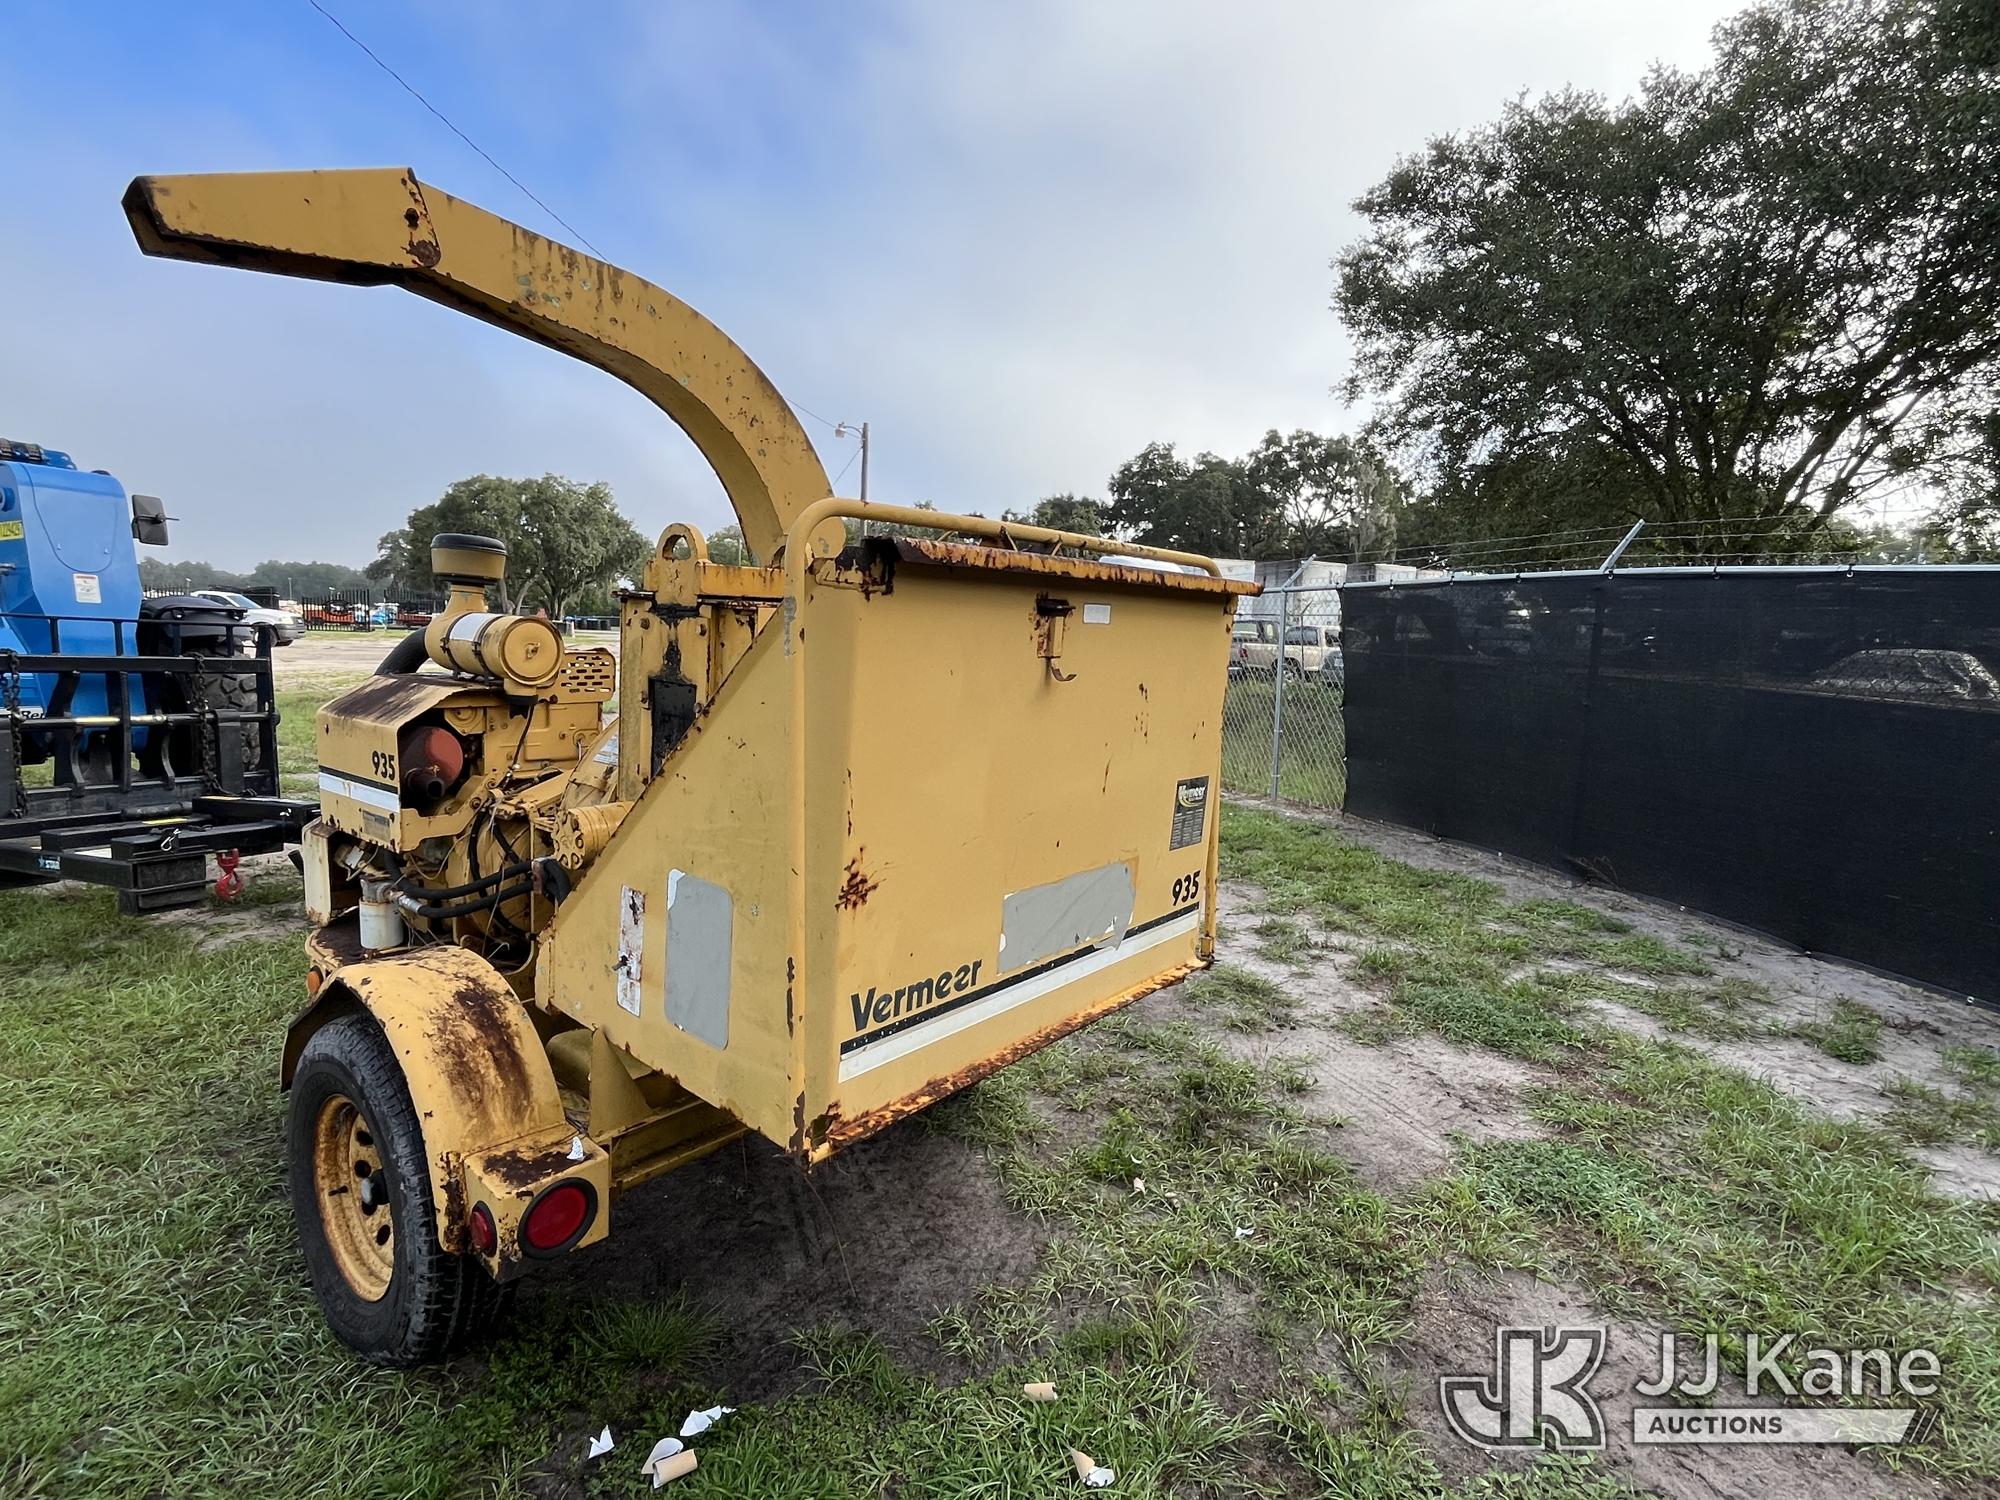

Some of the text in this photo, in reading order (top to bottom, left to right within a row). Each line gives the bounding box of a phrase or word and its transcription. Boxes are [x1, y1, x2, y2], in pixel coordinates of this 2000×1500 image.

[372, 750, 395, 780] 935
[1172, 870, 1201, 906] 935
[850, 959, 983, 1032] Vermeer
